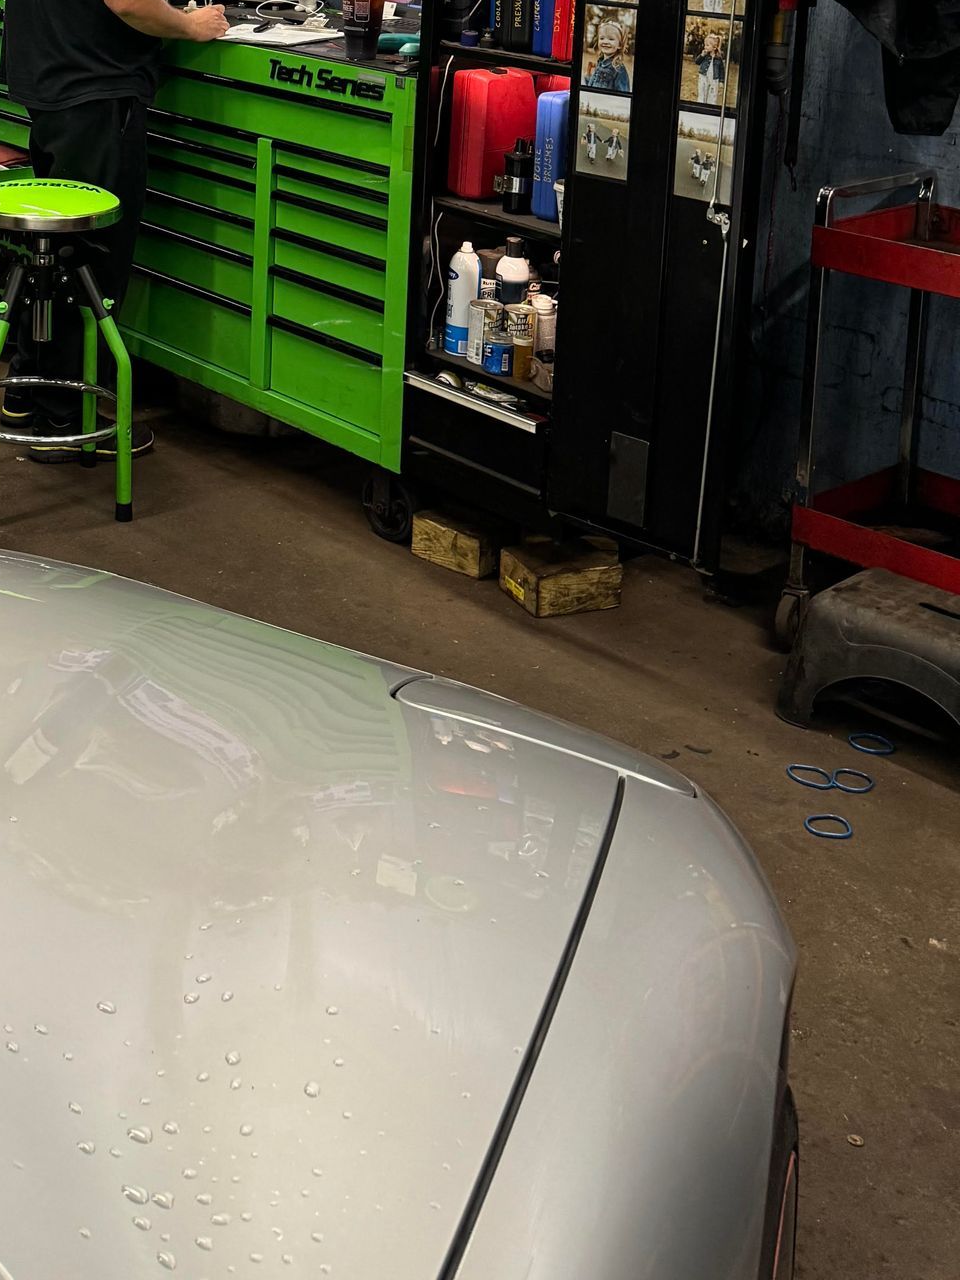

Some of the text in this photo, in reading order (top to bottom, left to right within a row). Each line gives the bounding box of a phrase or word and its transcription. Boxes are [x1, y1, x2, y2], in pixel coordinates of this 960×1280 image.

[553, 7, 562, 32] DIAL
[269, 58, 386, 102] Tech Series
